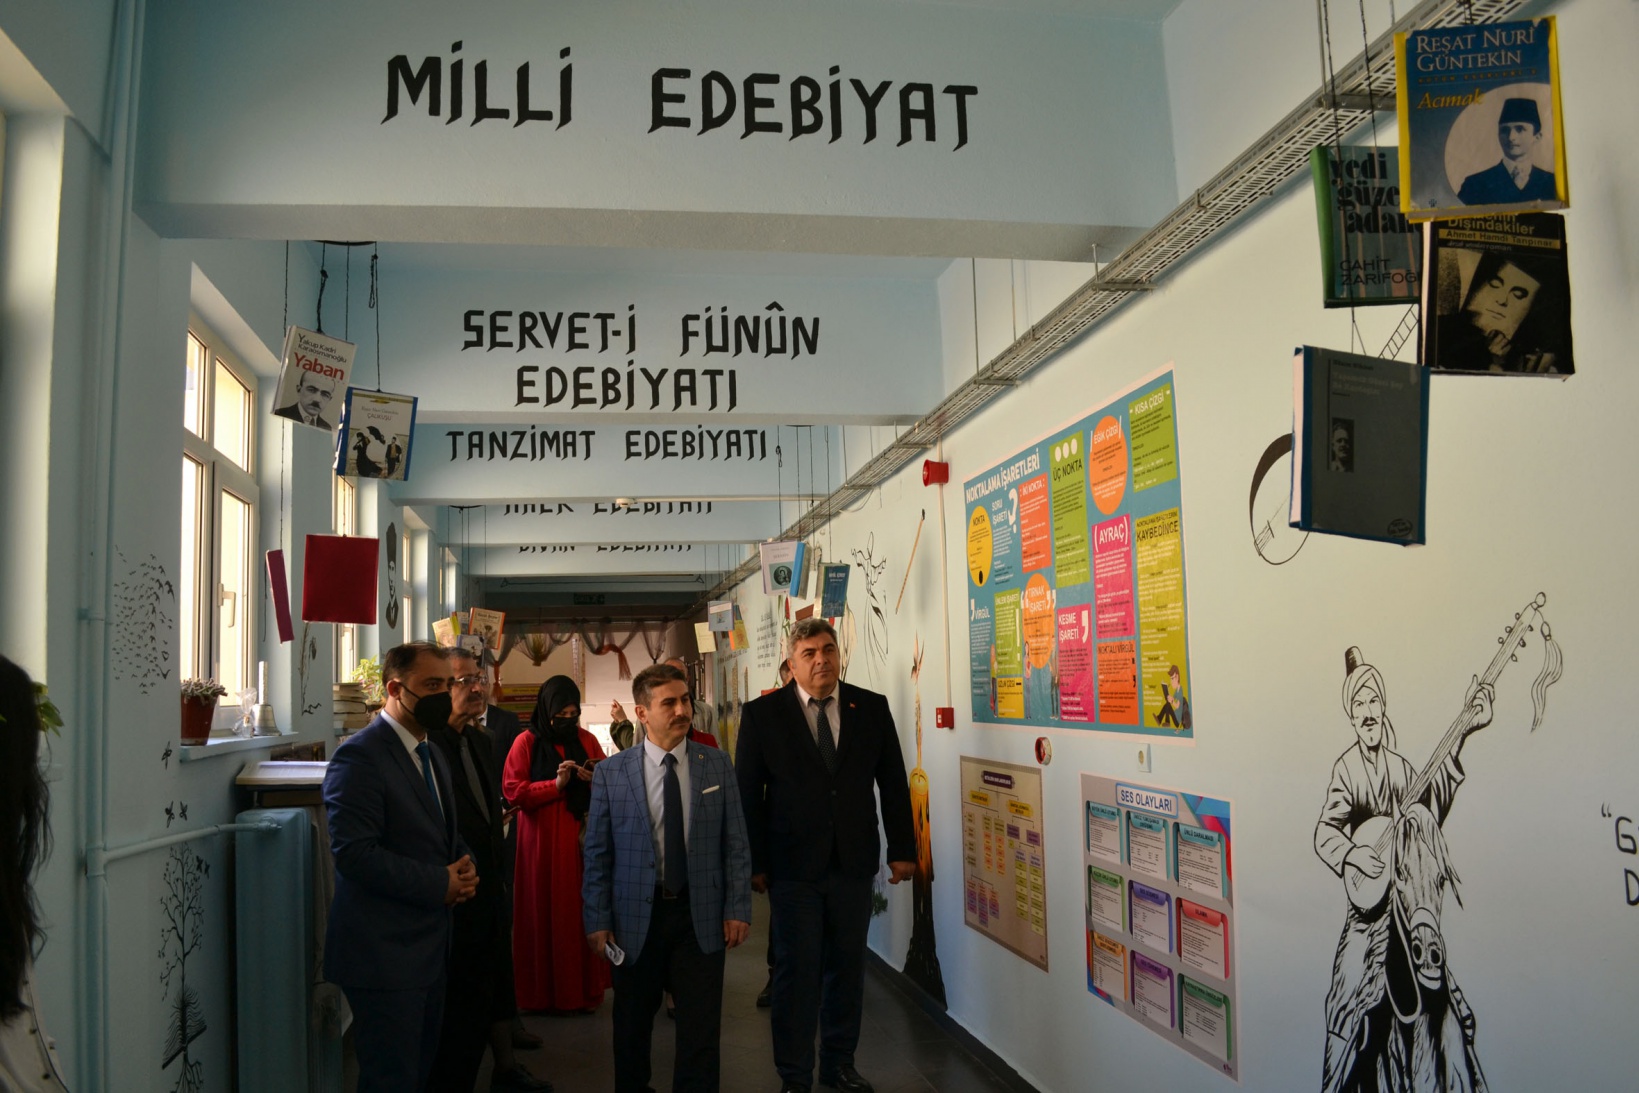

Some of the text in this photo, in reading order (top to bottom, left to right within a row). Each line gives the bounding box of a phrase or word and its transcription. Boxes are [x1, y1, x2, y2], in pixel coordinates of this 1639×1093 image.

[1416, 26, 1535, 55] REŞAT NURİ
[1416, 51, 1521, 73] GÜNTEKİN
[381, 40, 978, 151] MİLLİ EDEBİYAT
[1416, 88, 1486, 109] Acımak
[1337, 180, 1401, 211] güze
[1448, 219, 1535, 236] Dışındakiler
[1446, 229, 1553, 248] Ahmet Hamdi Tanpınar
[1340, 256, 1391, 272] CAHİT
[1342, 269, 1419, 286] ZARİFOĞ
[298, 333, 319, 349] Yakup
[461, 301, 820, 360] SERVET-İ FÜNÛN
[294, 352, 345, 381] Yaban
[514, 359, 737, 412] EDEBİYATI
[1134, 389, 1165, 415] KISA ÇİZGİ
[445, 424, 767, 462] TANZİMAT EDEBİYATI
[965, 447, 1040, 504] NOKTALAMA İŞARETLERİ
[1053, 458, 1083, 482] ÜÇ NOKTA
[1029, 480, 1043, 494] NOKTA
[991, 499, 1003, 512] SORU
[972, 514, 986, 527] NOKTA
[1136, 520, 1179, 543] KAYBEDİNCE
[1027, 585, 1045, 600] TIRNAK
[975, 606, 991, 619] VİRGÜL
[1058, 612, 1077, 625] KESME
[1060, 626, 1079, 643] İŞARETİ
[1120, 789, 1172, 812] SES OLAYLARI
